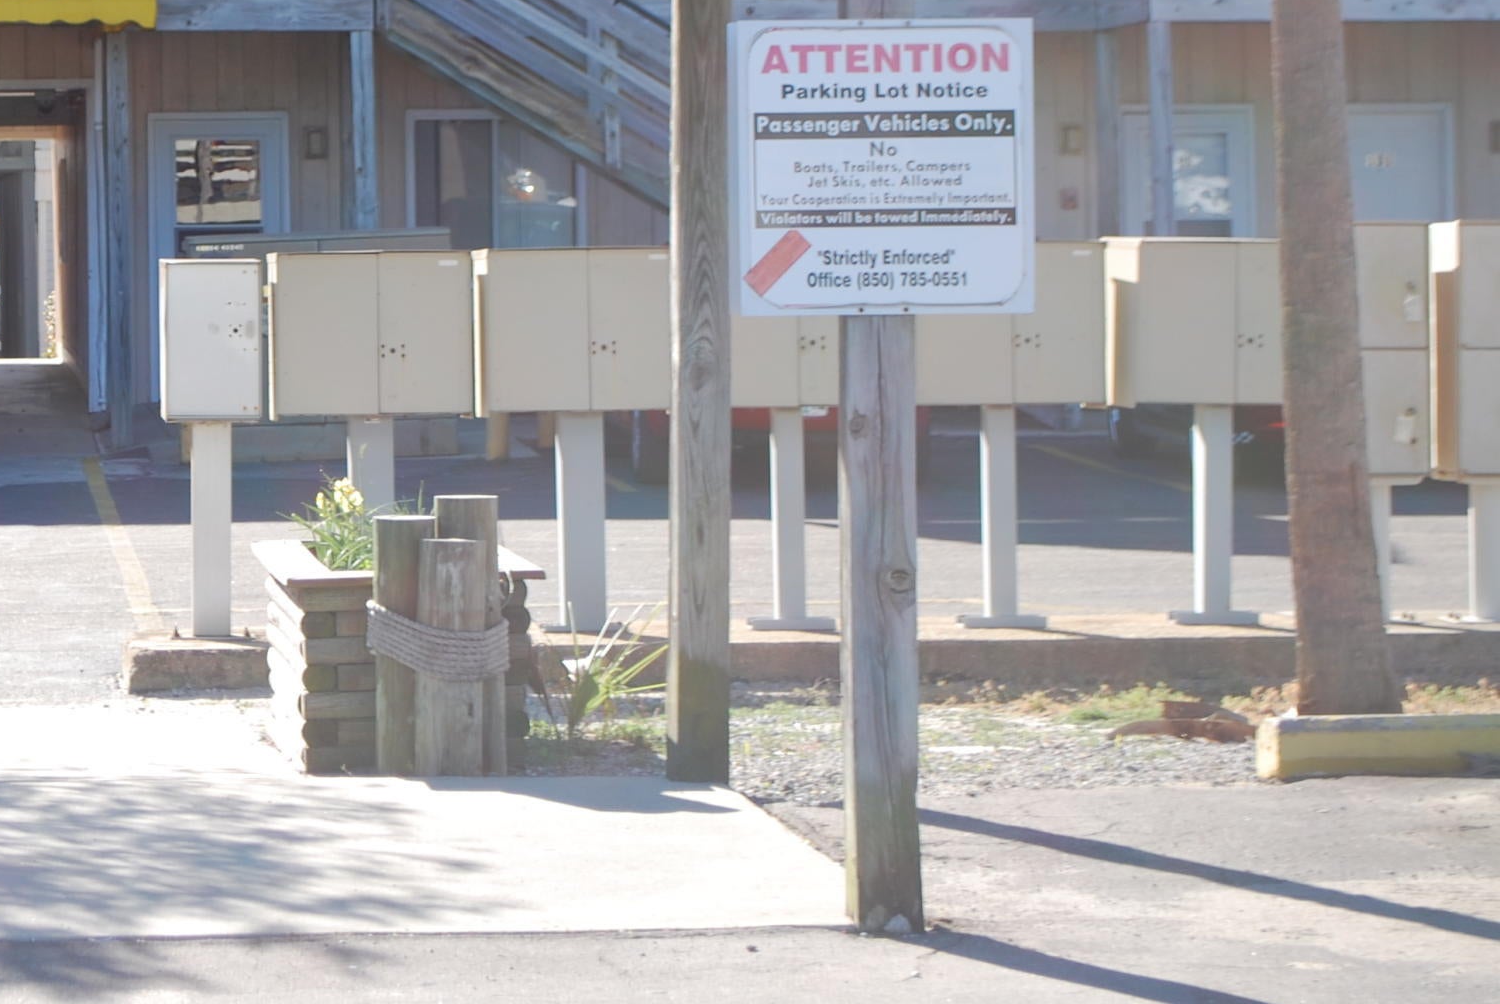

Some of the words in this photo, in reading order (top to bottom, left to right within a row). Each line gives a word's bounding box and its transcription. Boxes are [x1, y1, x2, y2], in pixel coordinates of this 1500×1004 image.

[761, 43, 1010, 73] ATTENTION
[781, 84, 866, 102] Parking
[875, 83, 908, 98] Lot
[917, 82, 988, 98] Notice
[756, 116, 860, 135] Passenger
[864, 113, 950, 132] Vehicles
[954, 112, 1013, 134] Only.
[870, 142, 897, 157] No
[794, 162, 838, 173] Boats,
[843, 160, 902, 173] Trailers,
[906, 160, 971, 174] Campers
[807, 176, 828, 188] Jet
[832, 175, 865, 188] Skis,
[870, 176, 896, 187] etc.
[900, 175, 962, 186] Allowed
[761, 195, 788, 205] Your
[792, 194, 867, 207] Cooperation
[870, 193, 880, 204] is
[884, 192, 943, 205] Extremely
[760, 213, 822, 224] Violators
[825, 212, 852, 223] will
[855, 212, 871, 223] be
[874, 211, 918, 223] towed
[817, 249, 877, 268] "Strictly
[883, 249, 955, 265] Enforced"
[807, 272, 851, 287] Office
[857, 272, 894, 290] (850)
[900, 272, 967, 286] 785-0551
